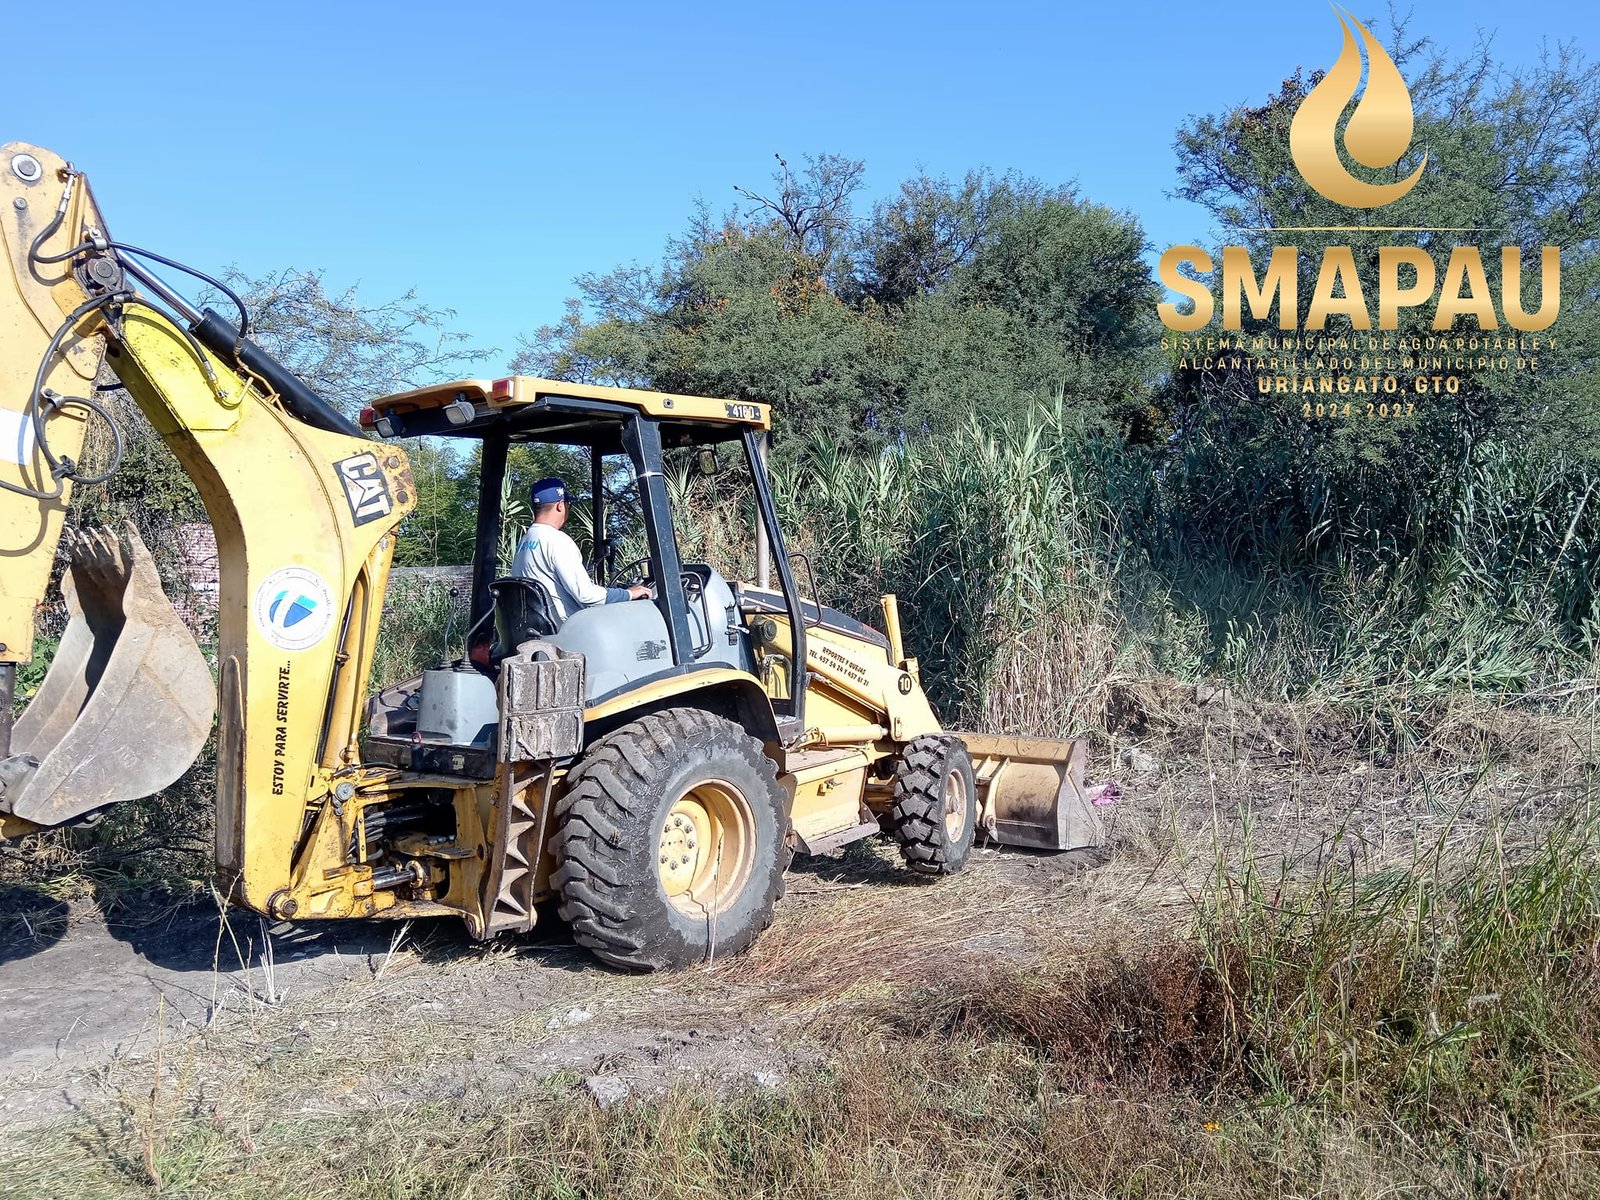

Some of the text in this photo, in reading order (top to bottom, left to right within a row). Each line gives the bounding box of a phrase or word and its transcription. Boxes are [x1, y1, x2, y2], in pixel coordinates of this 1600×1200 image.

[340, 454, 392, 518] CAT
[822, 646, 846, 664] REPORTES
[848, 661, 867, 676] QUEJAS
[899, 677, 911, 691] 10
[274, 726, 288, 757] PARA
[272, 759, 285, 796] ESTOY
